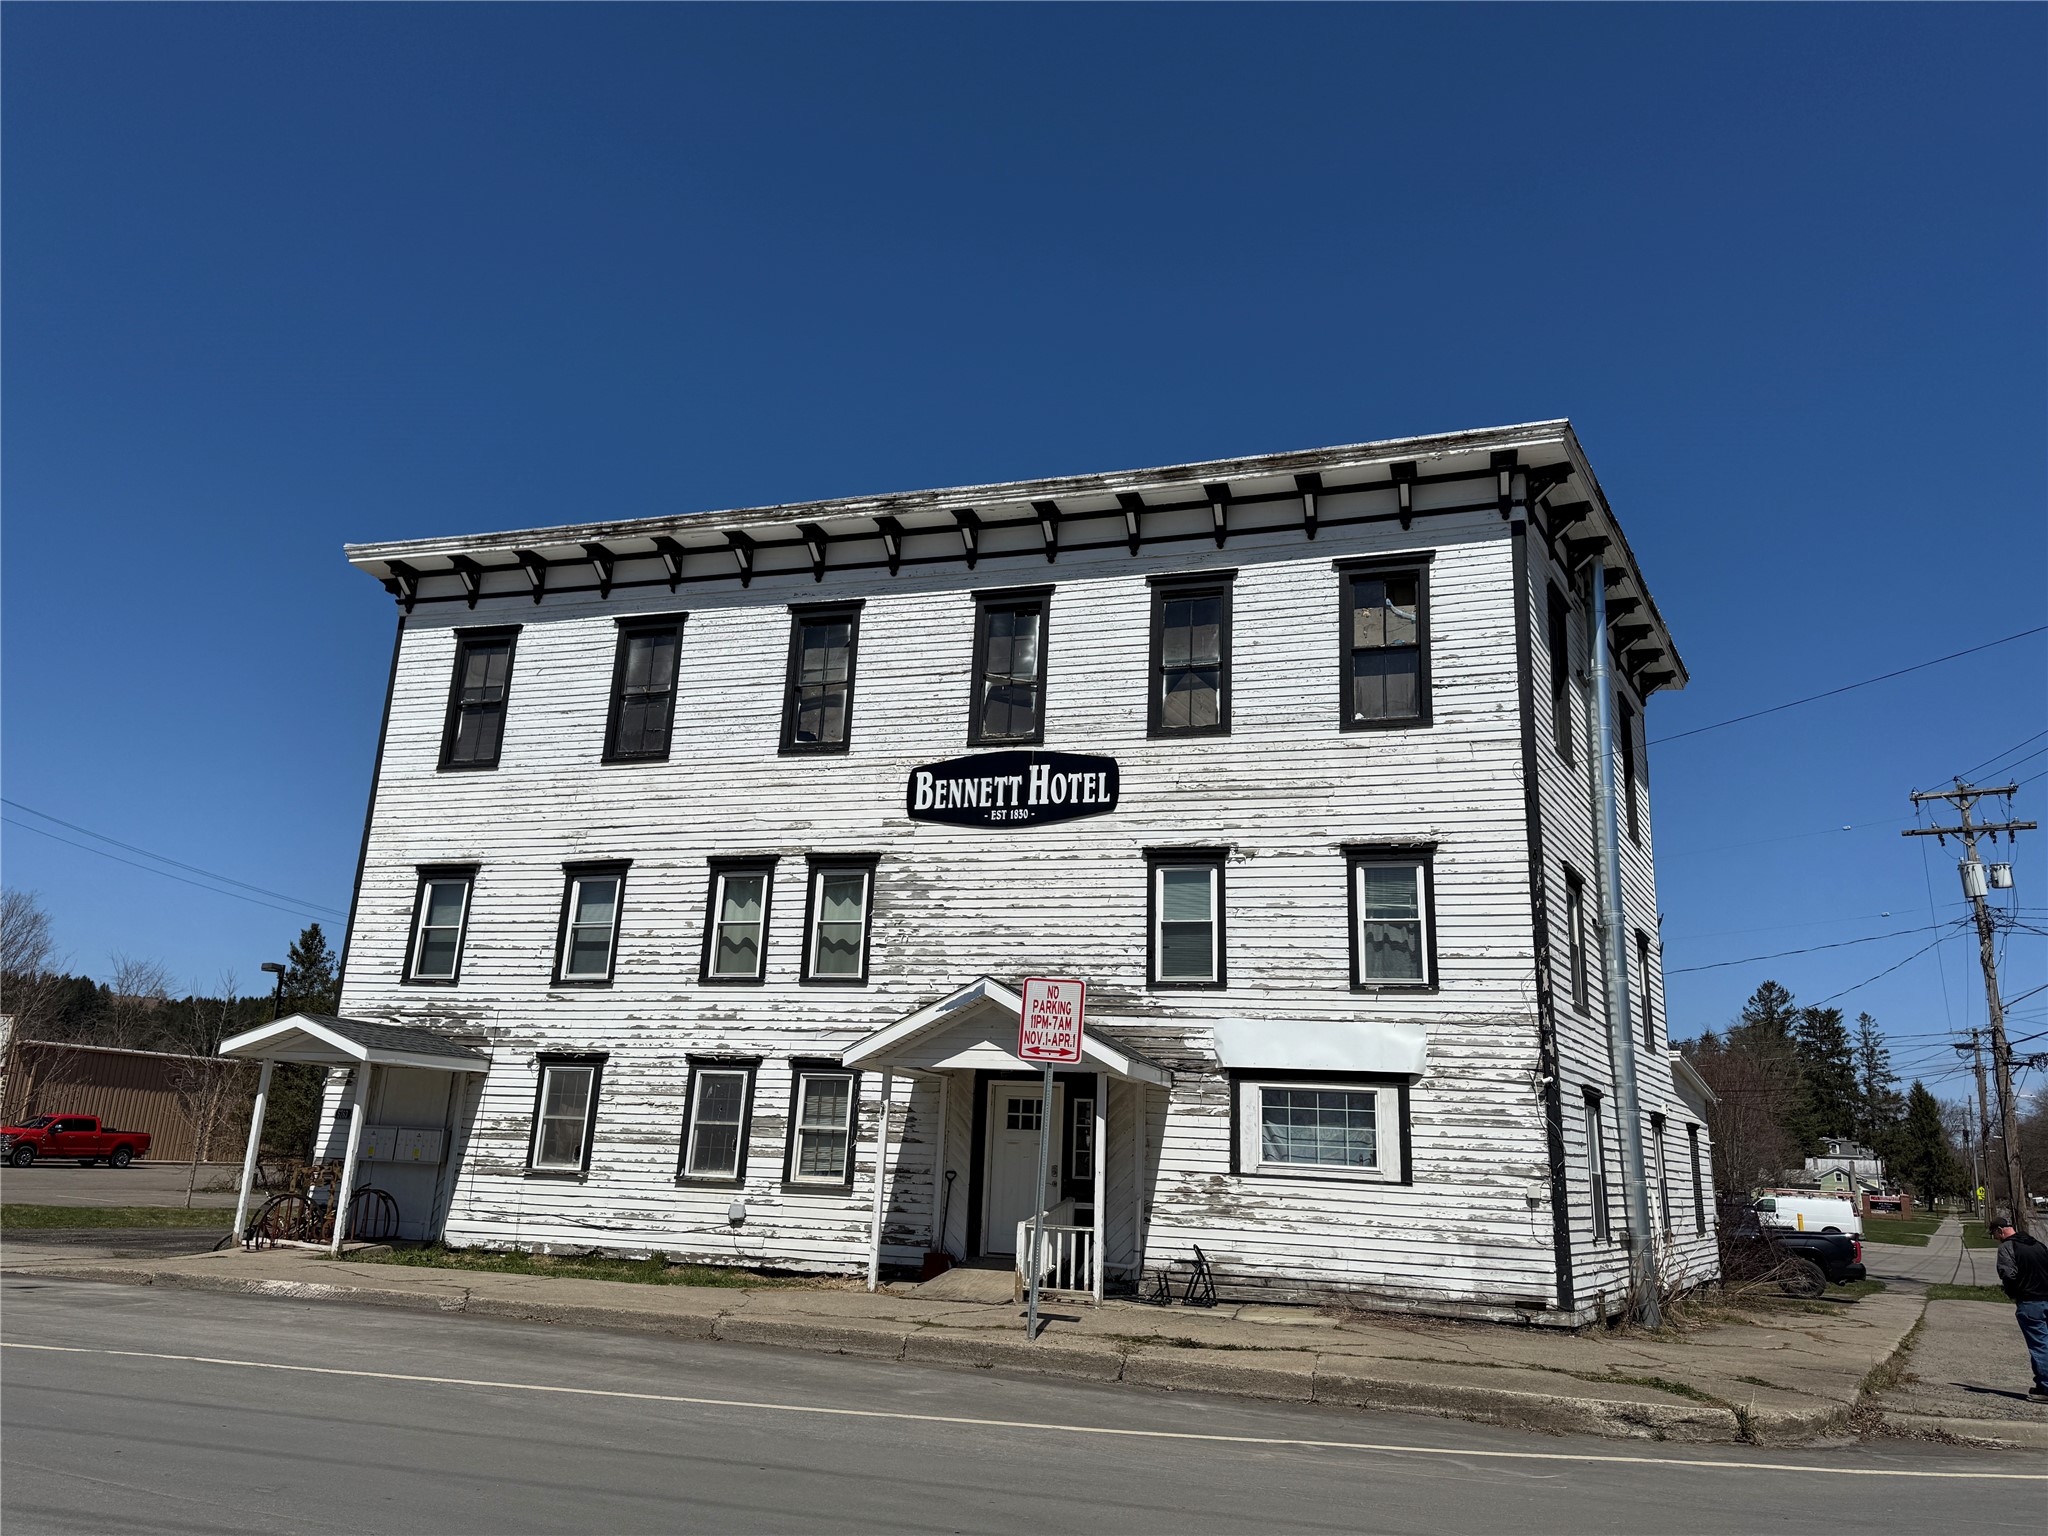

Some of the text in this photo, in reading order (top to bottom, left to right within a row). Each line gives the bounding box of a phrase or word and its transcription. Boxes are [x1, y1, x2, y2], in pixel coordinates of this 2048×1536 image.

[914, 764, 1110, 810] BENNETT HOTEL
[1010, 808, 1029, 820] 1830
[1047, 985, 1060, 999] NO
[1032, 999, 1072, 1015] PARKING
[1030, 1014, 1072, 1031] 11PM-7AM
